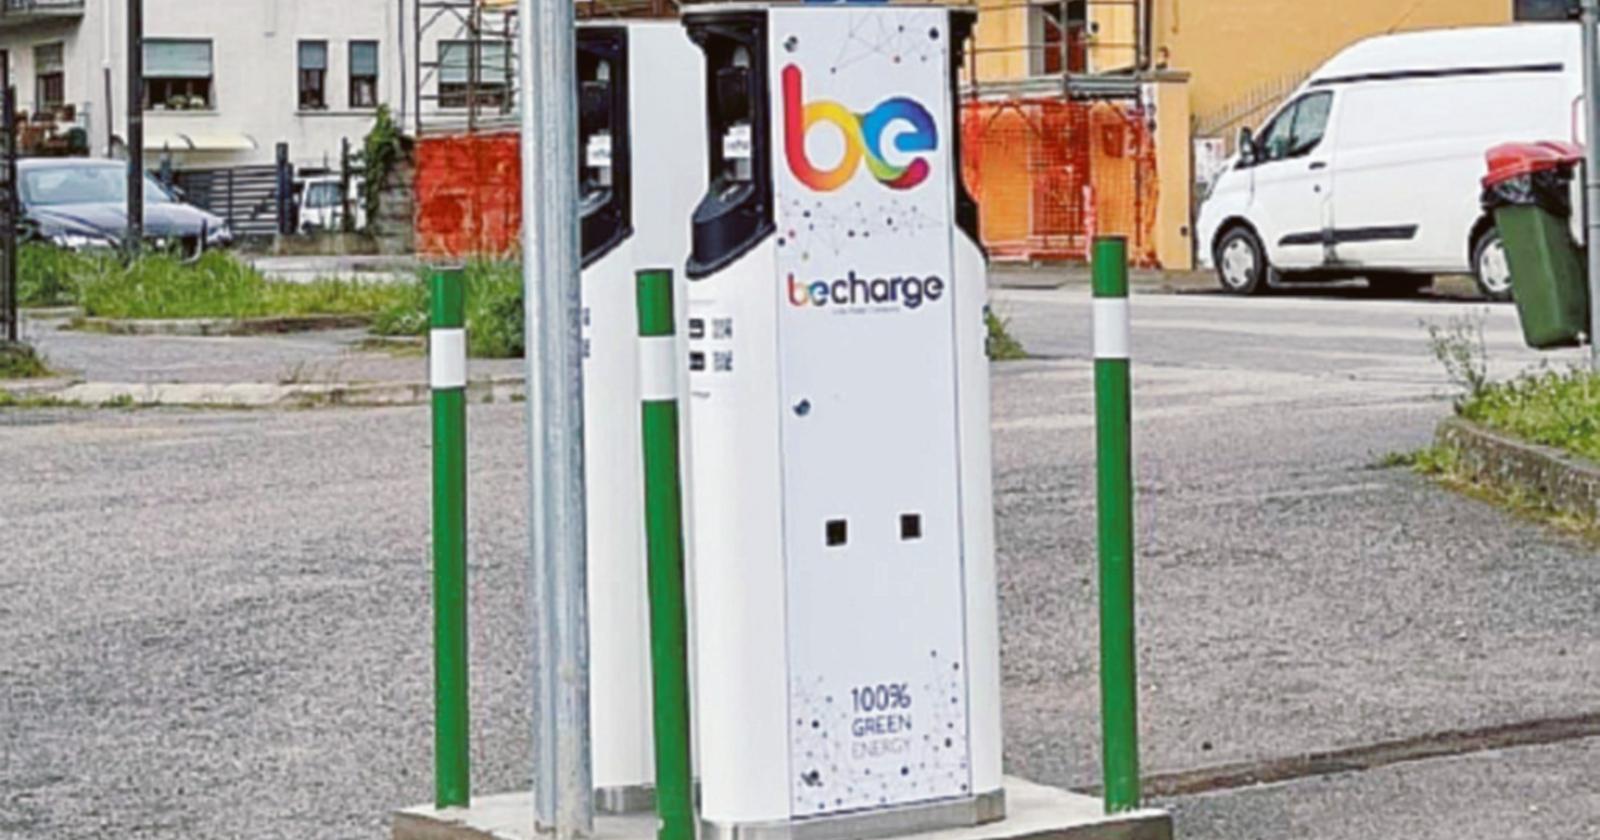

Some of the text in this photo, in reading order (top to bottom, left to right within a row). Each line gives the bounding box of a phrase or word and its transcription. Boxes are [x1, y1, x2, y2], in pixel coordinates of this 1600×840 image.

[781, 63, 938, 192] be
[787, 270, 944, 309] becharge
[851, 684, 912, 713] 100%
[852, 715, 913, 737] GREEN
[852, 737, 912, 760] ENERGY
